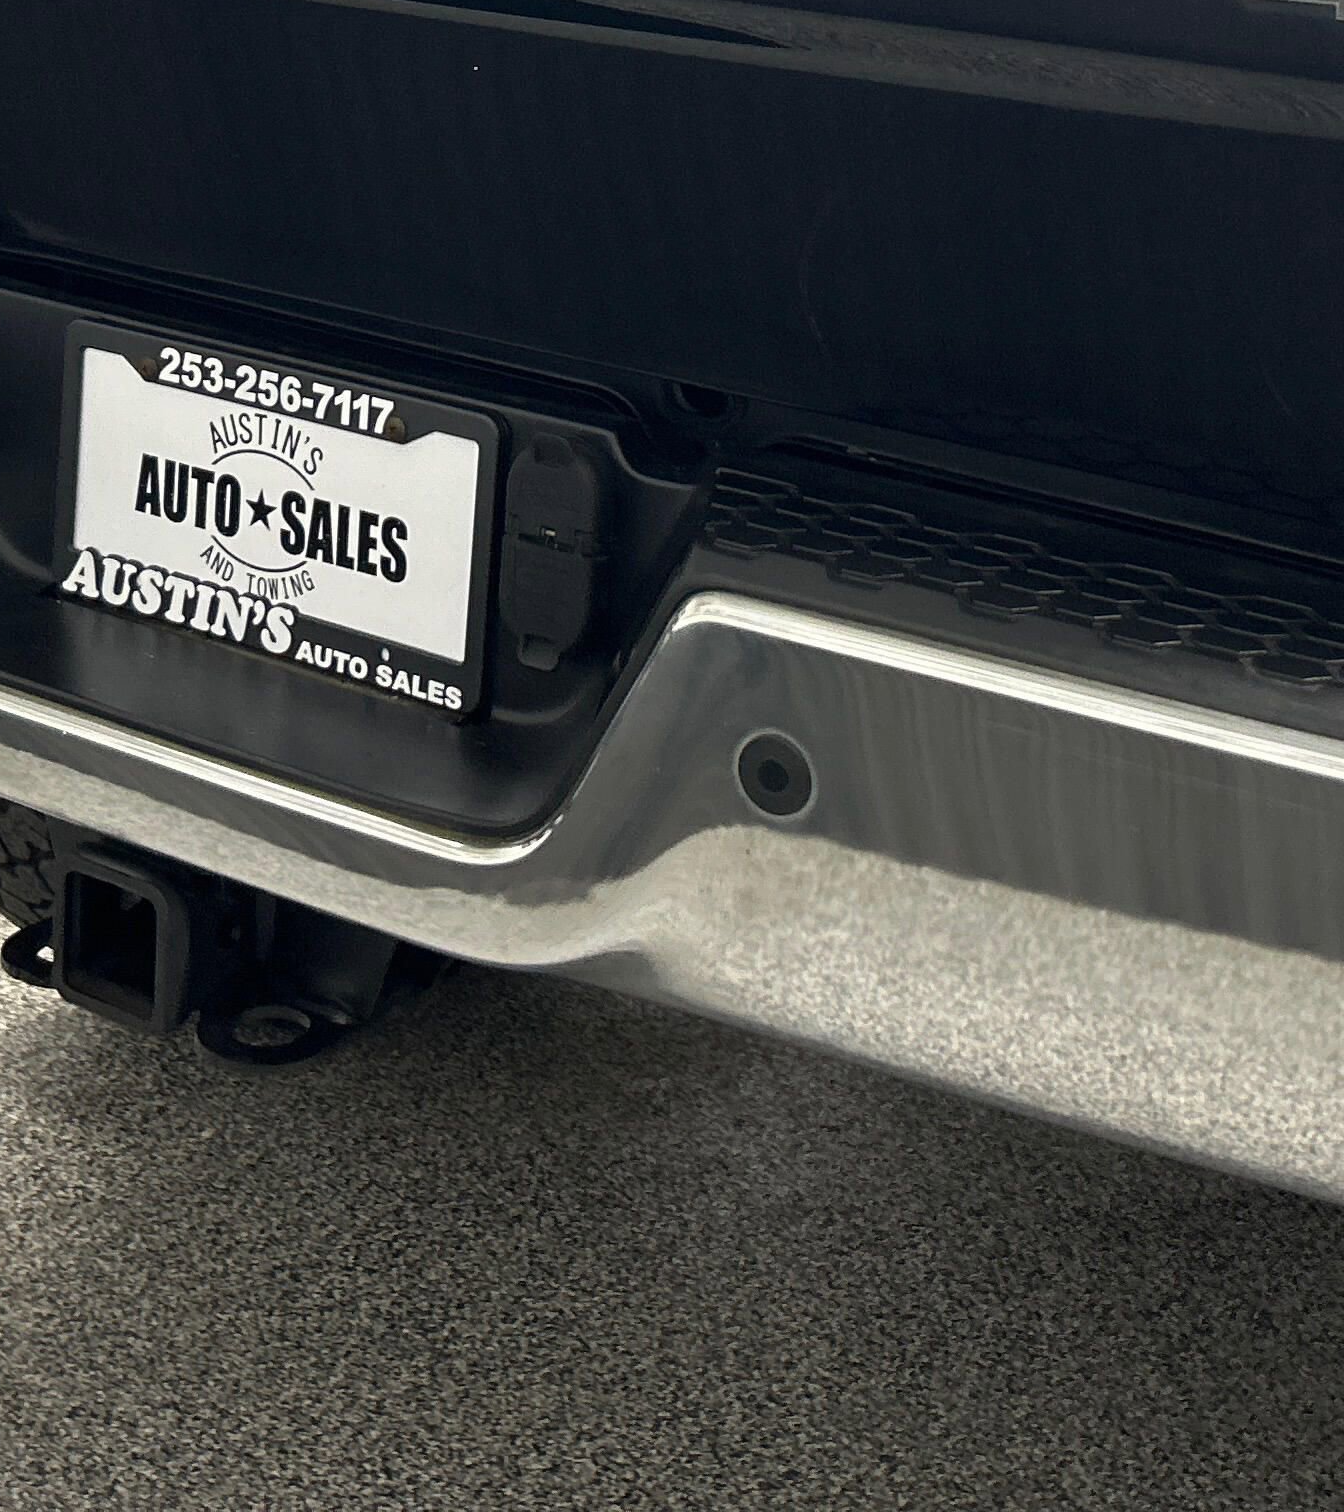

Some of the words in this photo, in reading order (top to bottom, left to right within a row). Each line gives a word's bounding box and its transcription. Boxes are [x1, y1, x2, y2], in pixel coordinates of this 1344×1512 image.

[158, 346, 395, 435] 253-256-7117
[209, 411, 324, 476] AUSTIN'S
[134, 452, 242, 538] AUTO
[279, 490, 409, 583] SALES
[199, 544, 235, 582] AND
[246, 570, 317, 601] TOWING
[61, 549, 295, 655] AUSTIN'S
[294, 640, 369, 680] AUTO
[374, 663, 464, 711] SALES
